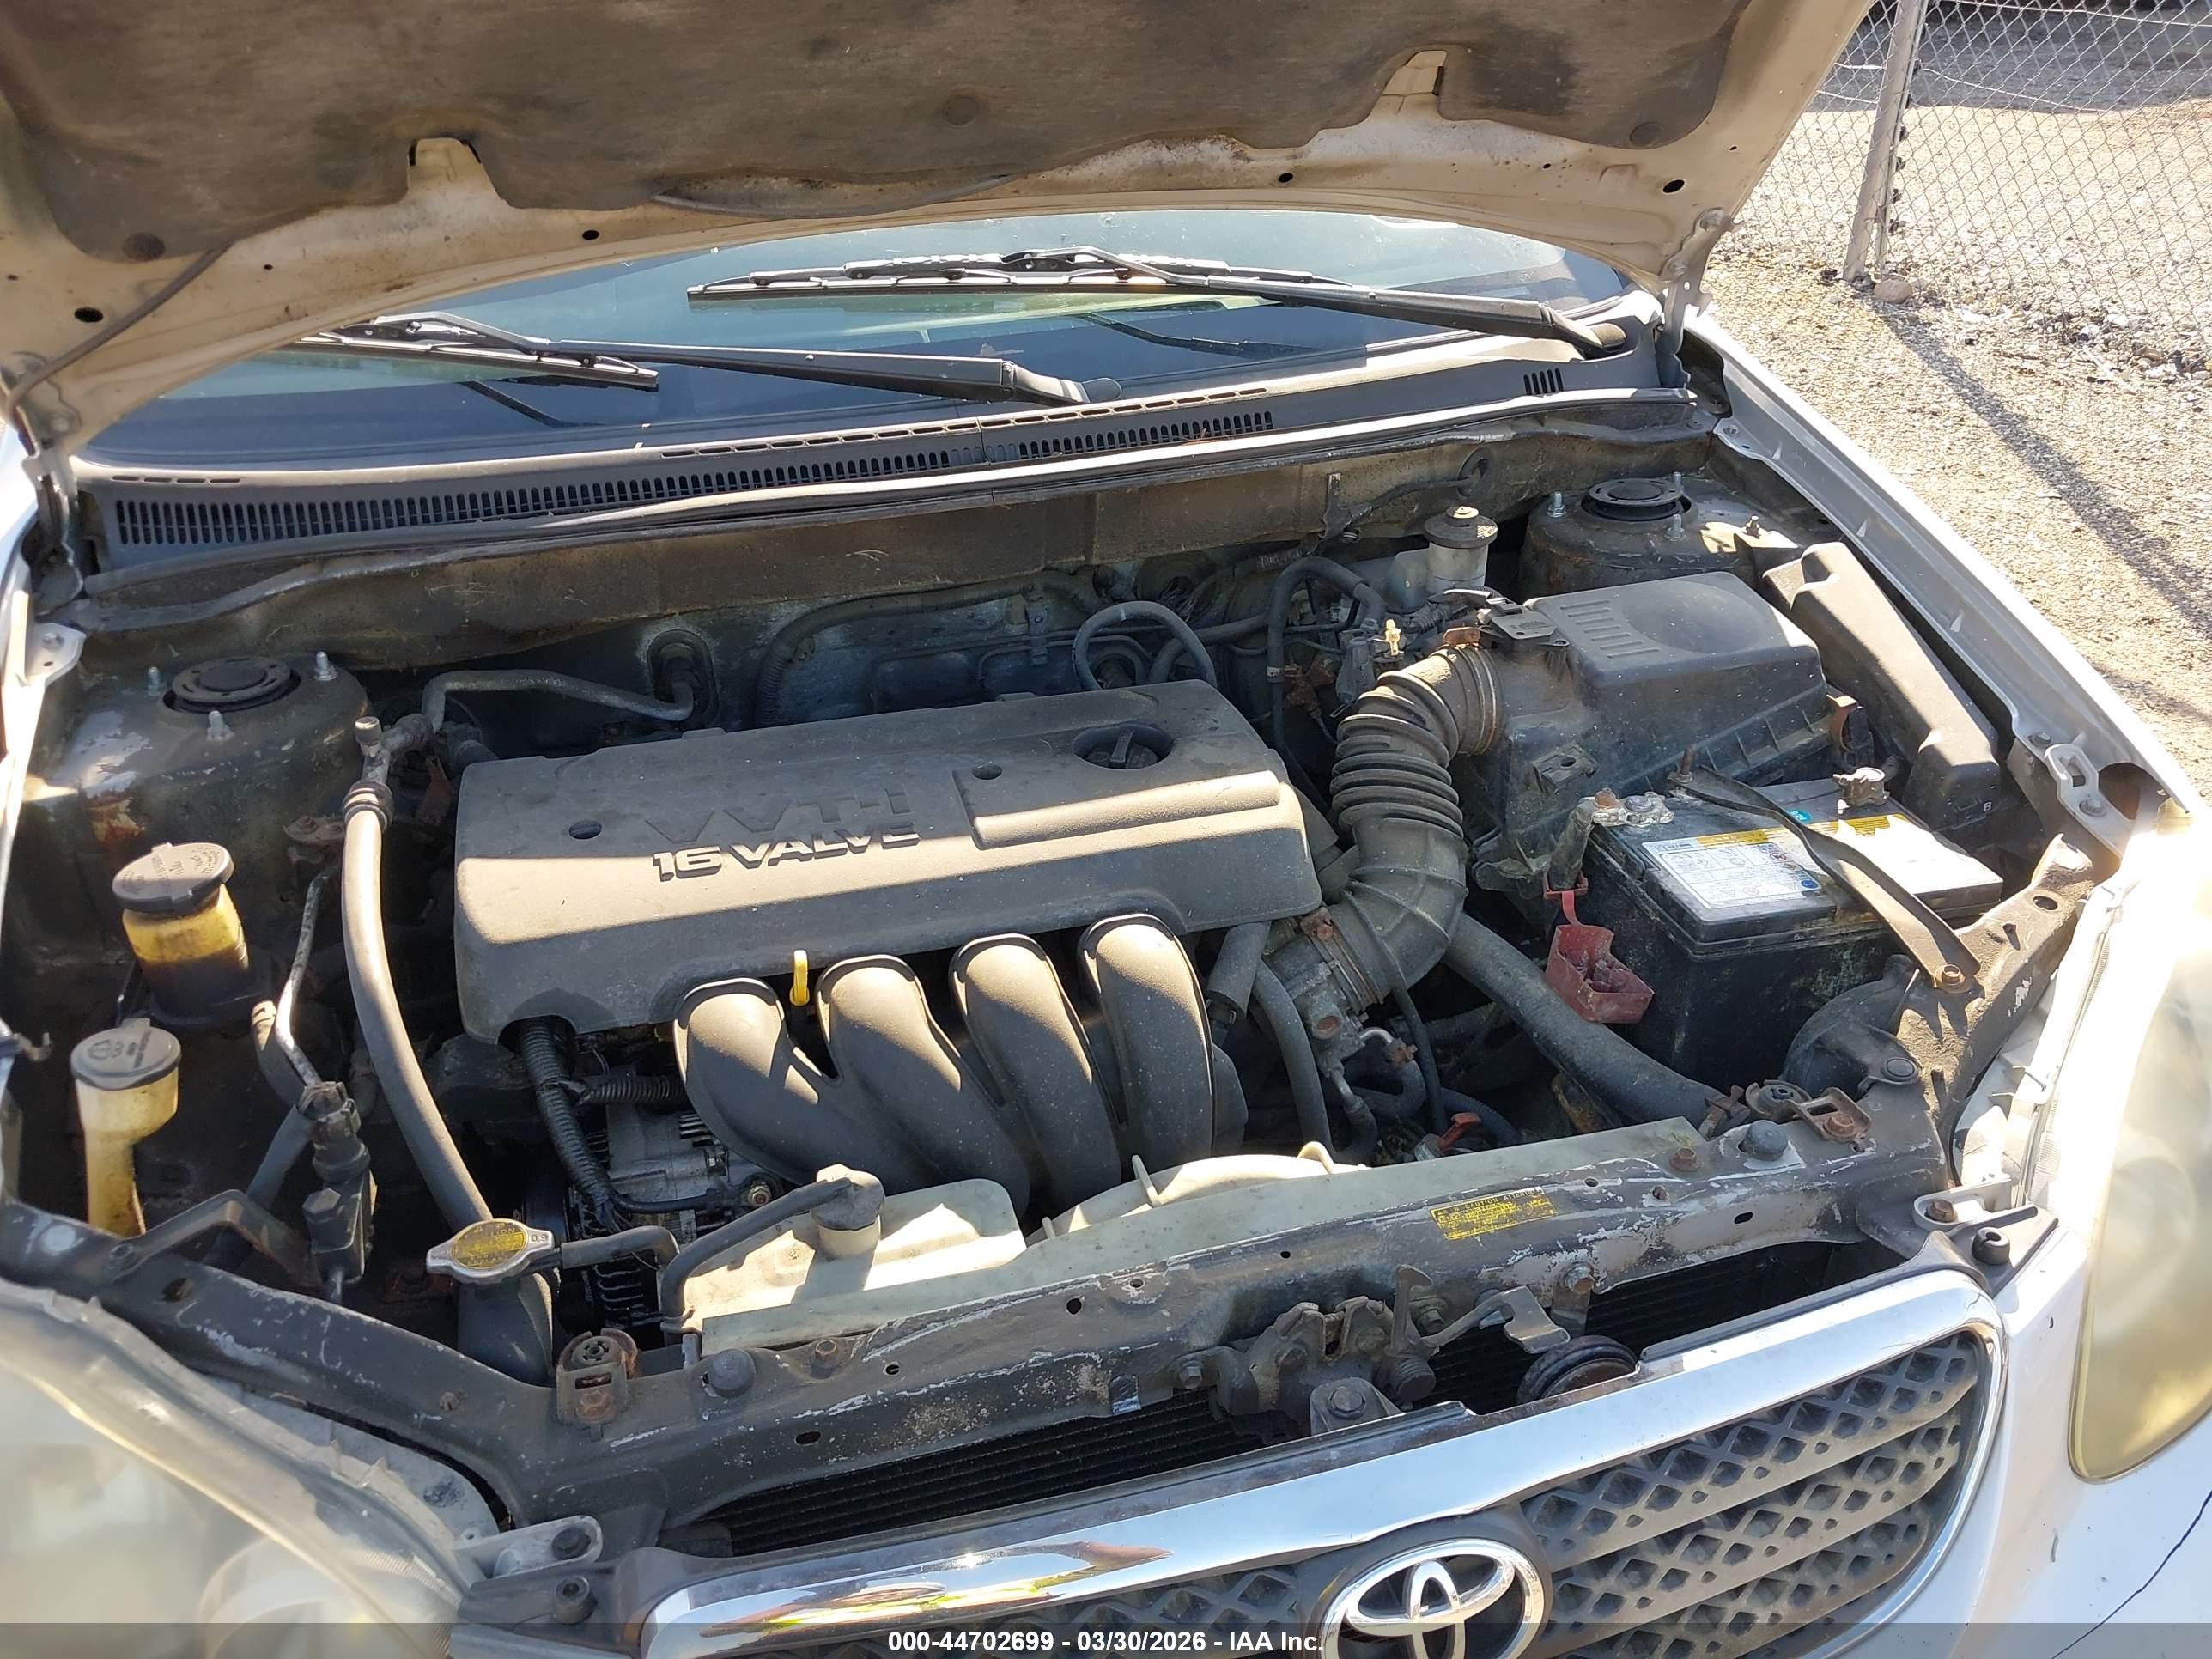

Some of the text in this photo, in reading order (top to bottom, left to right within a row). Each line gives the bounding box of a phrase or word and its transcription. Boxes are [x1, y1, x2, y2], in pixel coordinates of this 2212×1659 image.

[653, 822, 921, 882] 16 VALVE
[1465, 1198, 1498, 1209] CAUTION
